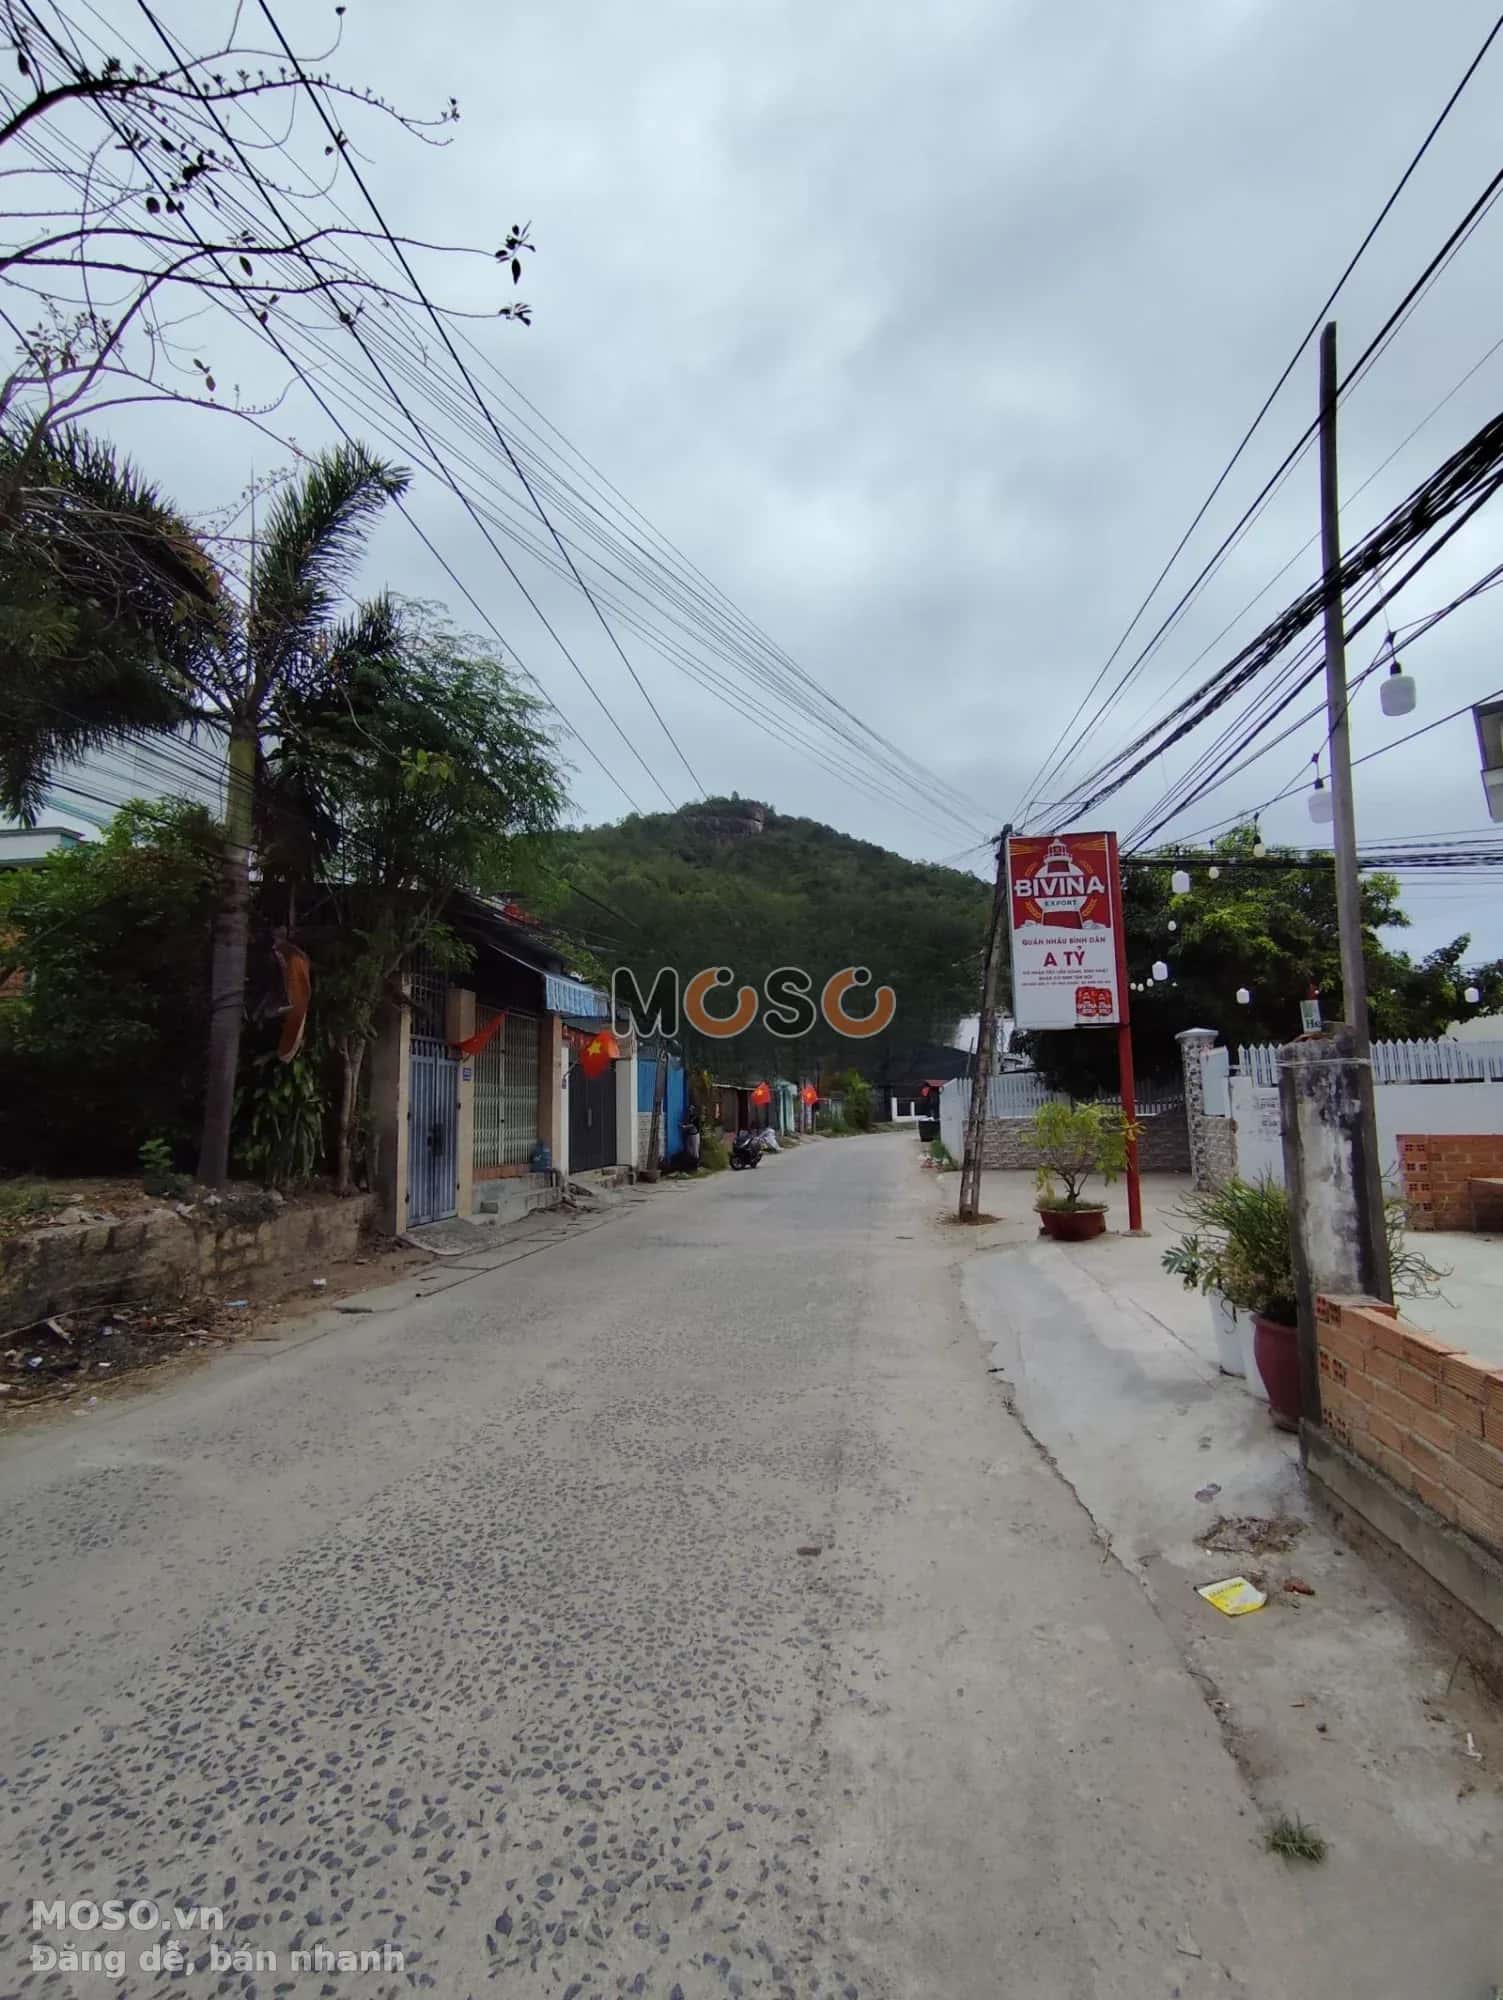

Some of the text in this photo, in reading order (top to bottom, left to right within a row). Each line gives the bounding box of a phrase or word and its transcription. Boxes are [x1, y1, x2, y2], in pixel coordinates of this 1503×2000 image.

[1014, 875, 1105, 897] BIVINA
[1044, 899, 1077, 907] EXPORT
[1088, 935, 1106, 944] DÂN
[1043, 945, 1085, 967] A TỶ
